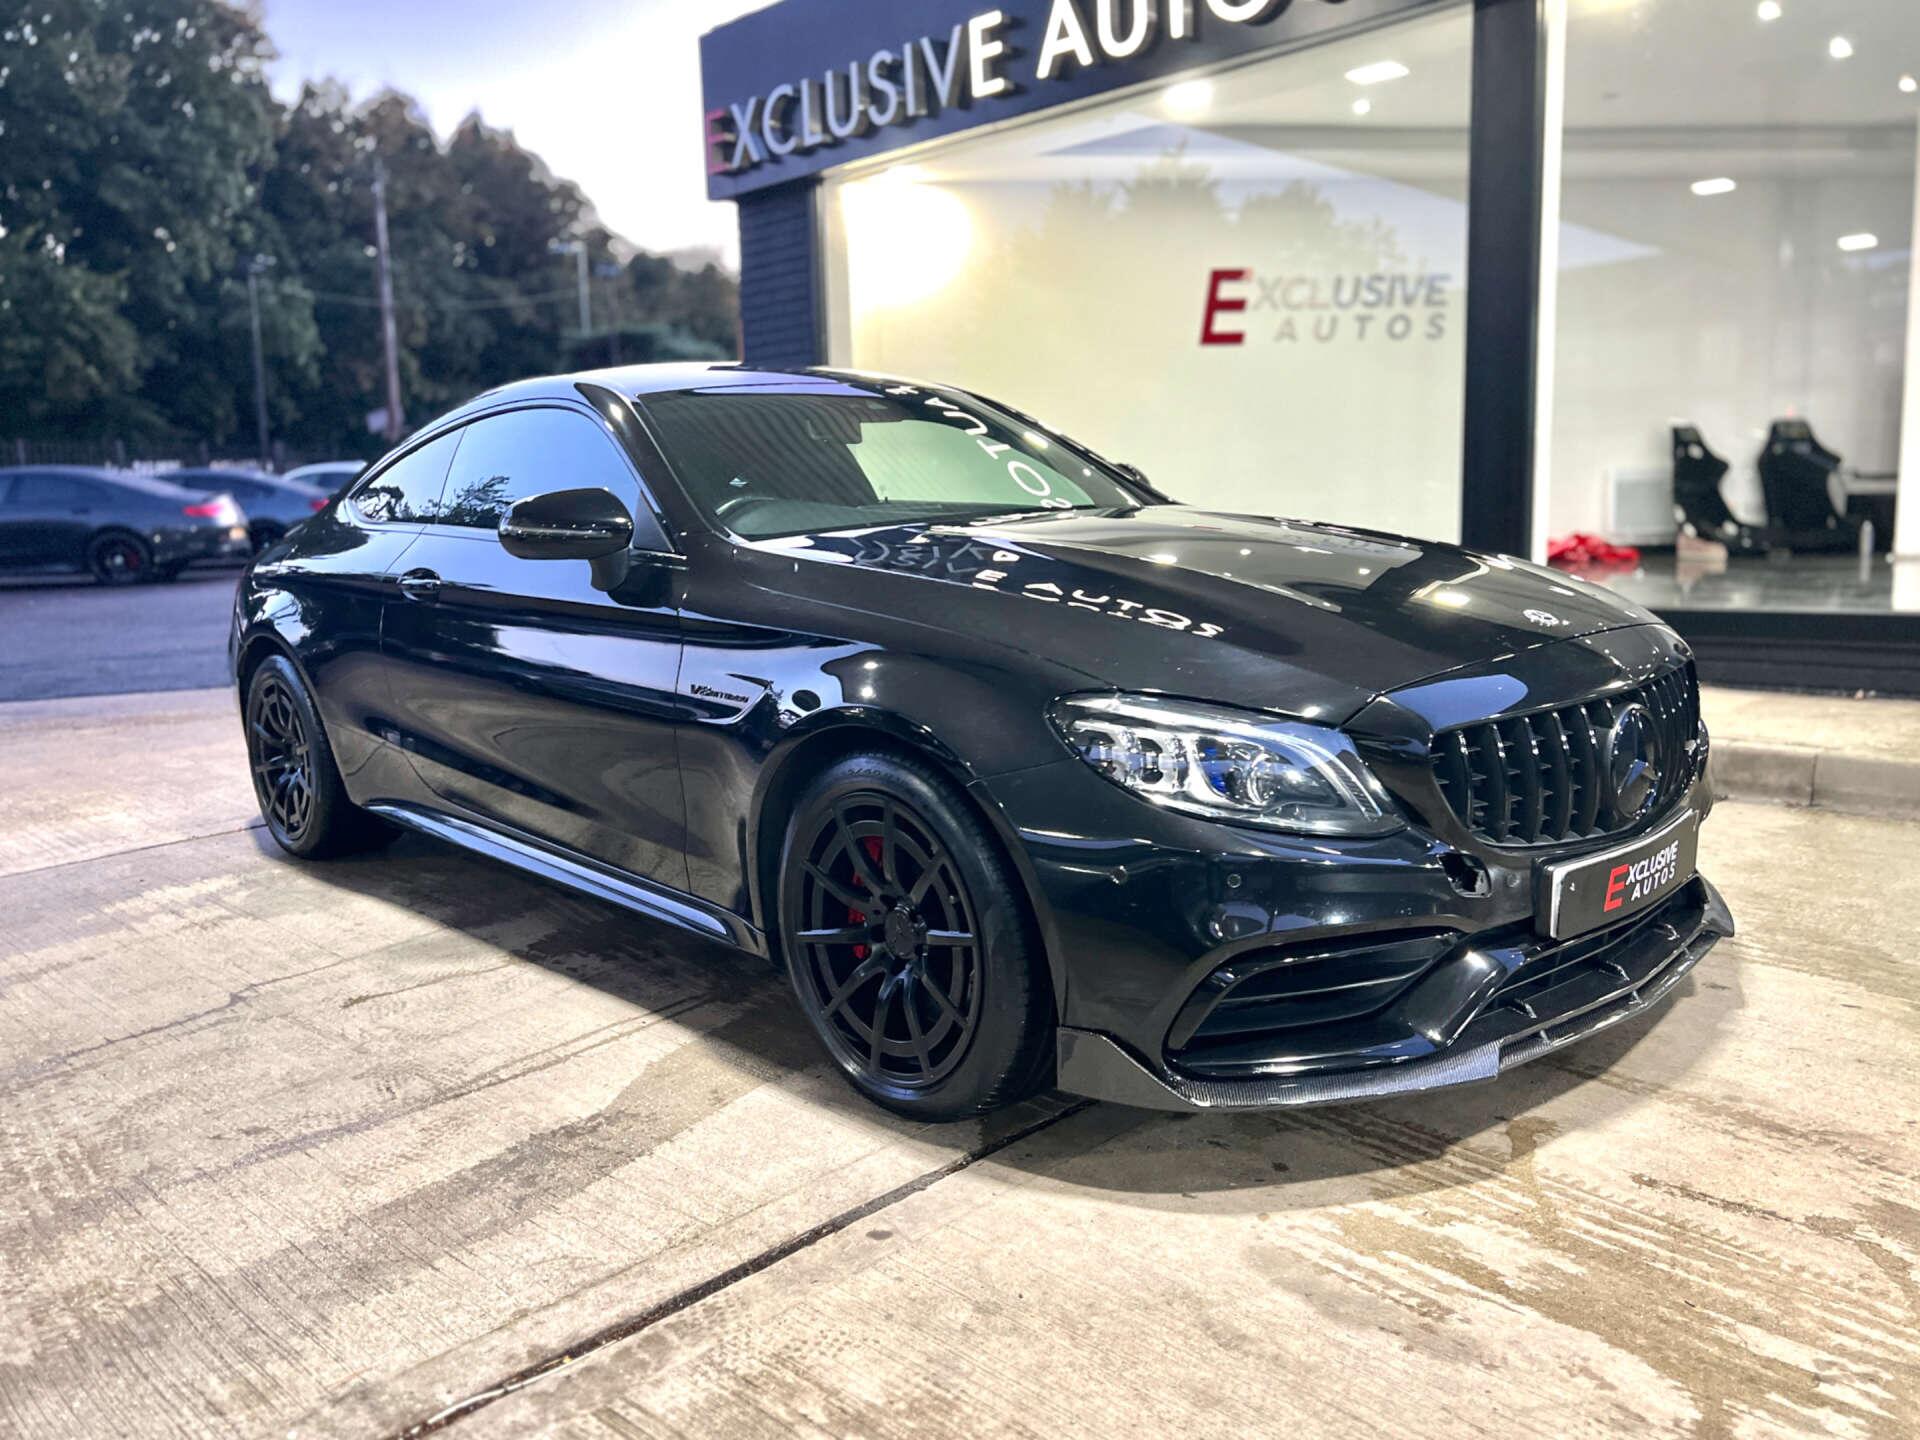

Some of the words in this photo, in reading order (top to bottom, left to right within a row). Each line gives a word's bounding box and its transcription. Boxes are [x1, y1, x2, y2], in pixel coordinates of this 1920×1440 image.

[705, 9, 1006, 176] EXCLUSIVE
[1200, 268, 1453, 346] EXCLUSIVE
[1274, 312, 1447, 343] AUTOS
[1603, 840, 1679, 913] EXCLUSIVE
[1630, 861, 1676, 901] AUTOS
